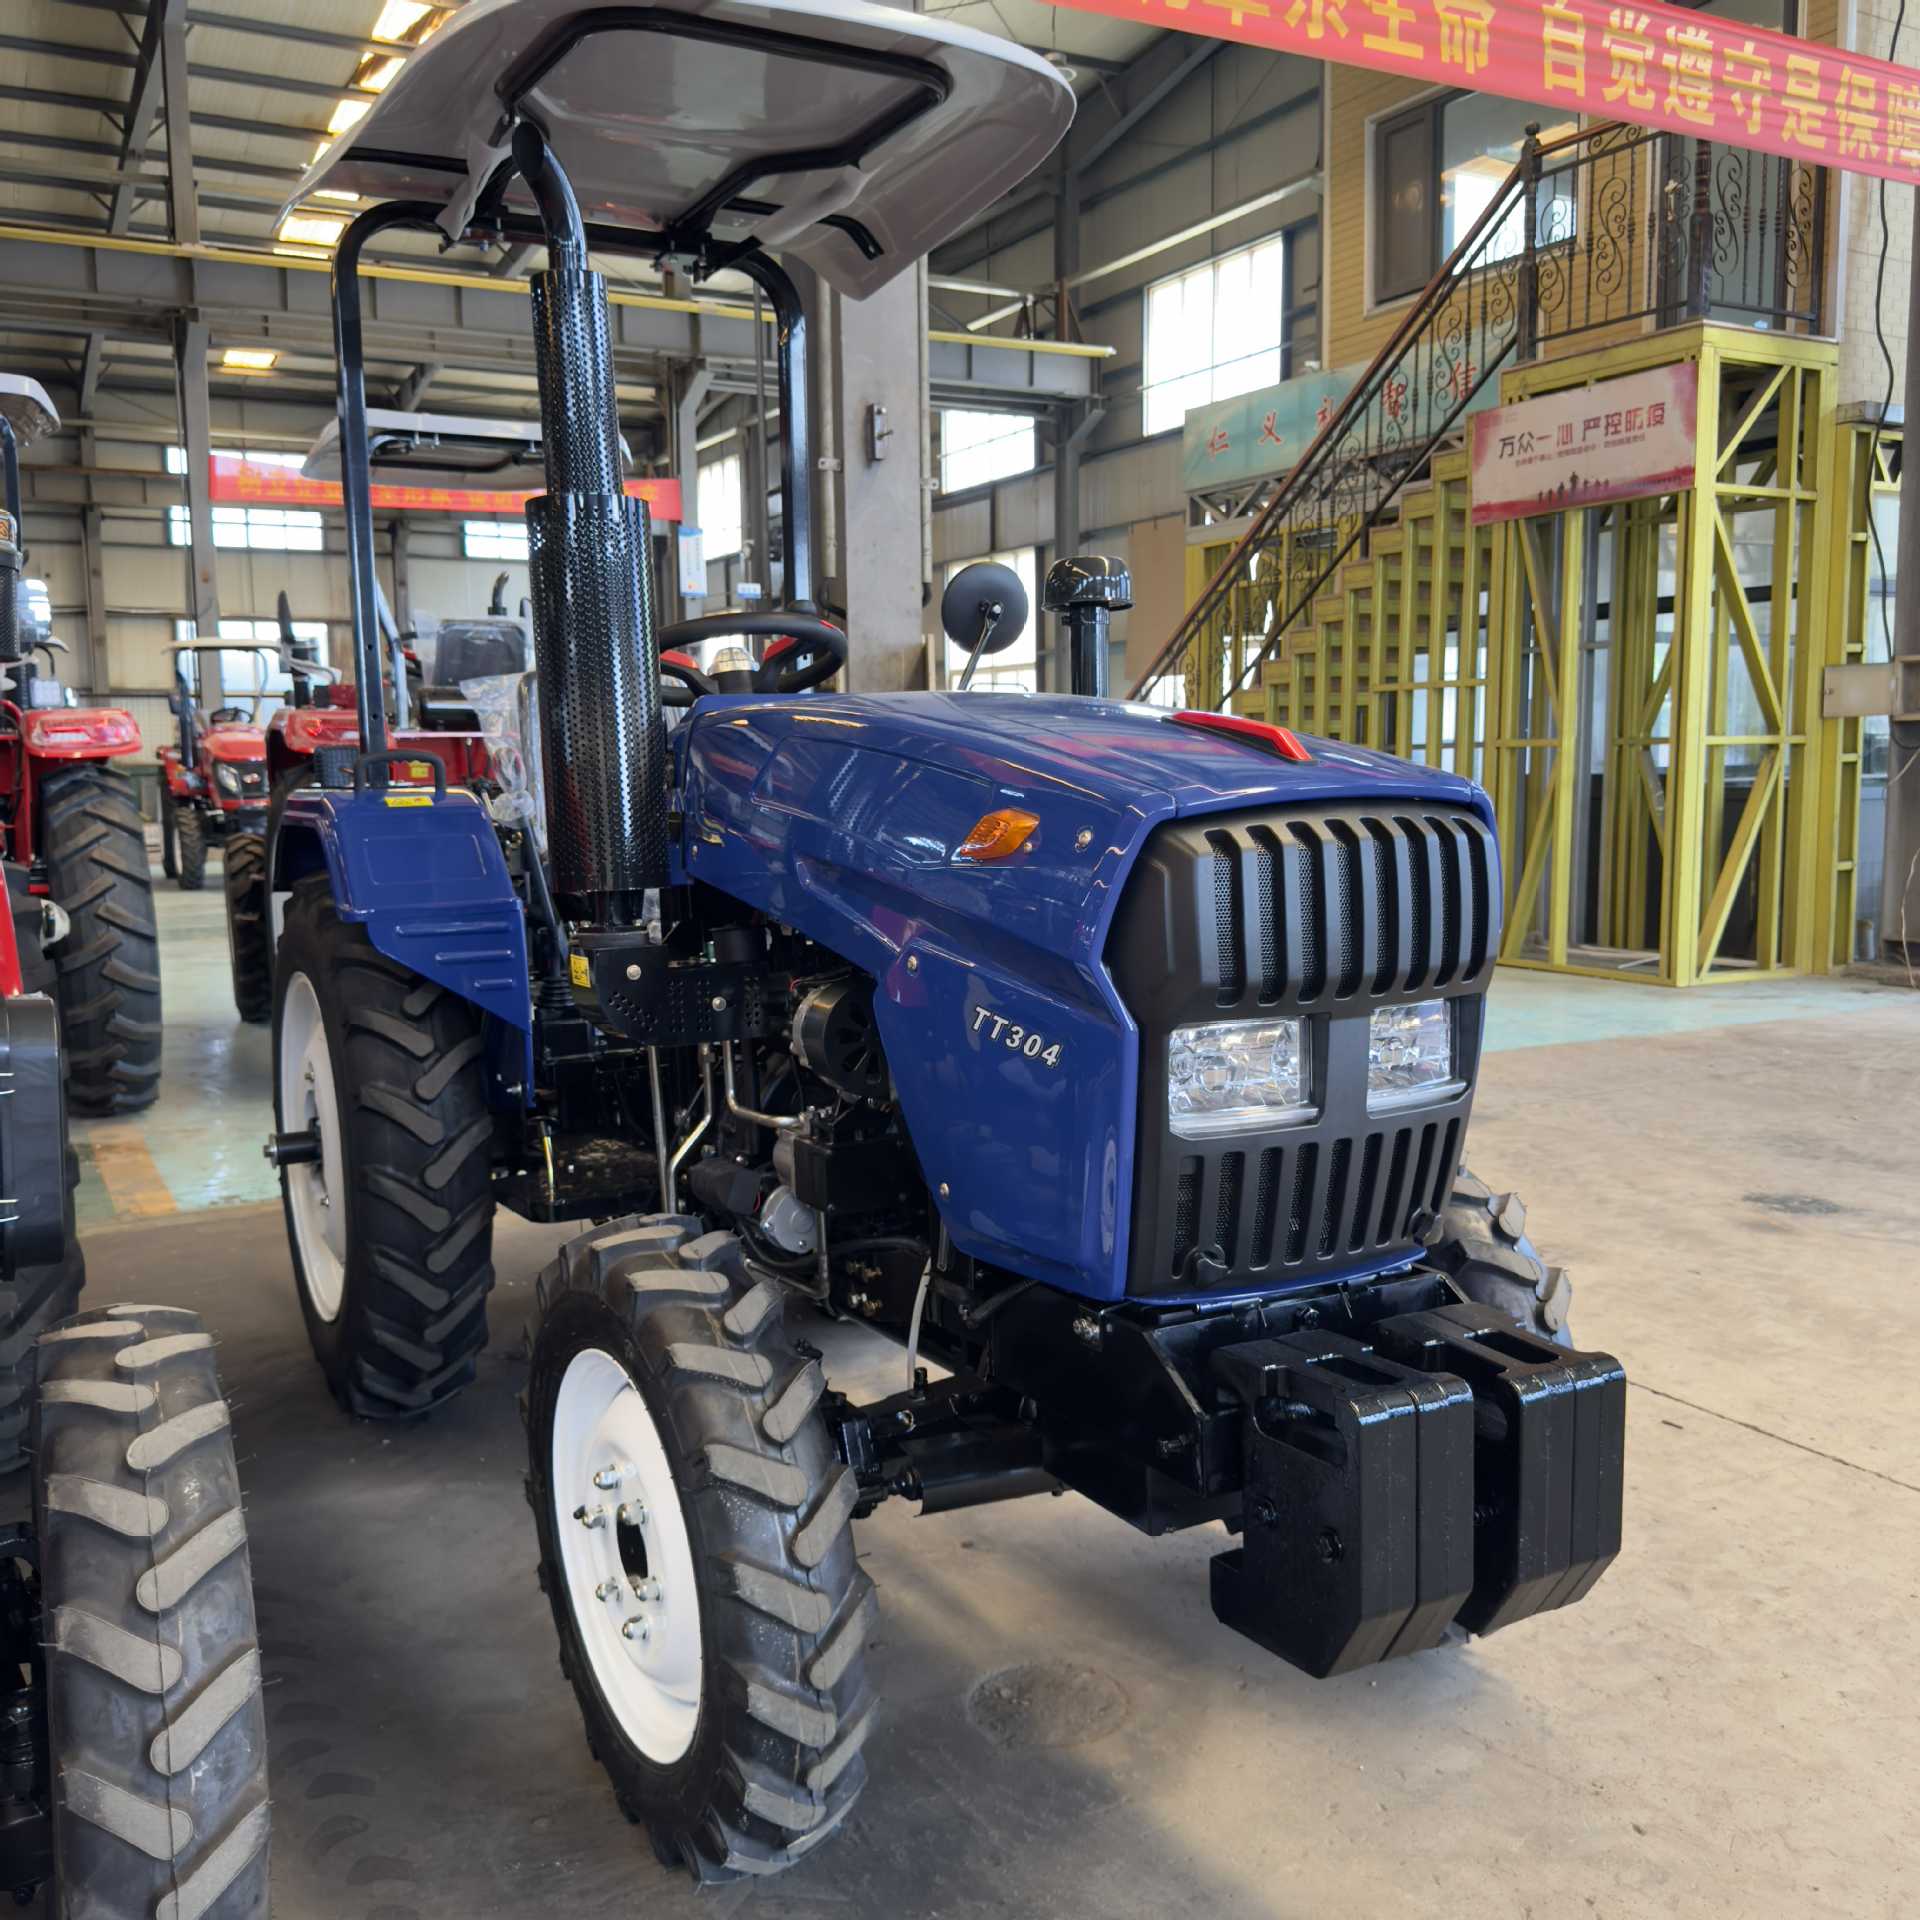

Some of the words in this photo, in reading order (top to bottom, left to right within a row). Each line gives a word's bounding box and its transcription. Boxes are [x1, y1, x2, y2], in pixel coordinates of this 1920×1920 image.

[1499, 422, 1574, 459] 万众一心
[1582, 402, 1665, 442] 严控防疫
[972, 1005, 1062, 1067] TT304
